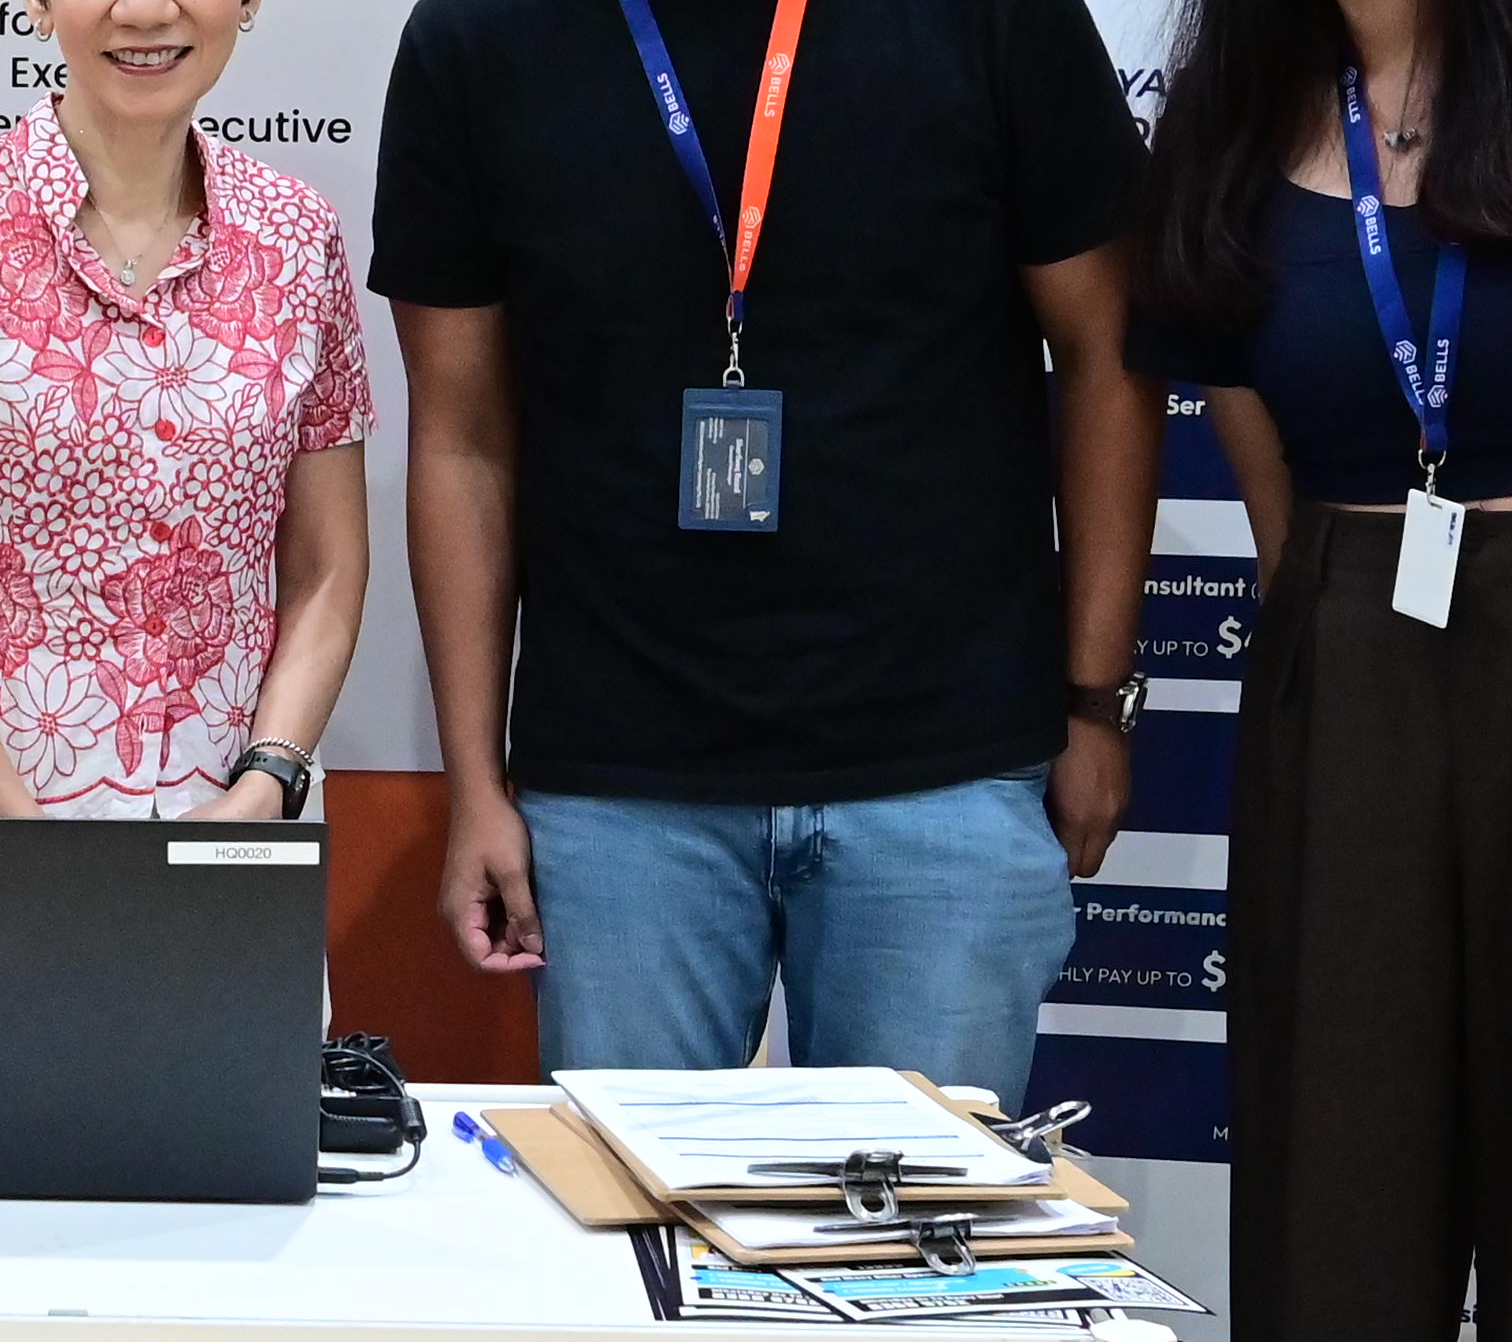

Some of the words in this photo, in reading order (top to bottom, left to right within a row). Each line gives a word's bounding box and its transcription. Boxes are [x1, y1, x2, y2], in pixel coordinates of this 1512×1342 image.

[656, 72, 679, 115] BELLS
[764, 75, 782, 118] BELLS
[1346, 86, 1361, 124] BELLS
[739, 228, 754, 272] BELLS
[1365, 216, 1382, 255] BELLS
[1433, 338, 1450, 384] BELLS
[1153, 641, 1178, 655] UP
[1182, 642, 1209, 656] TO
[215, 847, 272, 859] HQ0020
[1098, 968, 1133, 984] PAY
[1137, 970, 1161, 985] UP
[1166, 971, 1192, 987] TO
